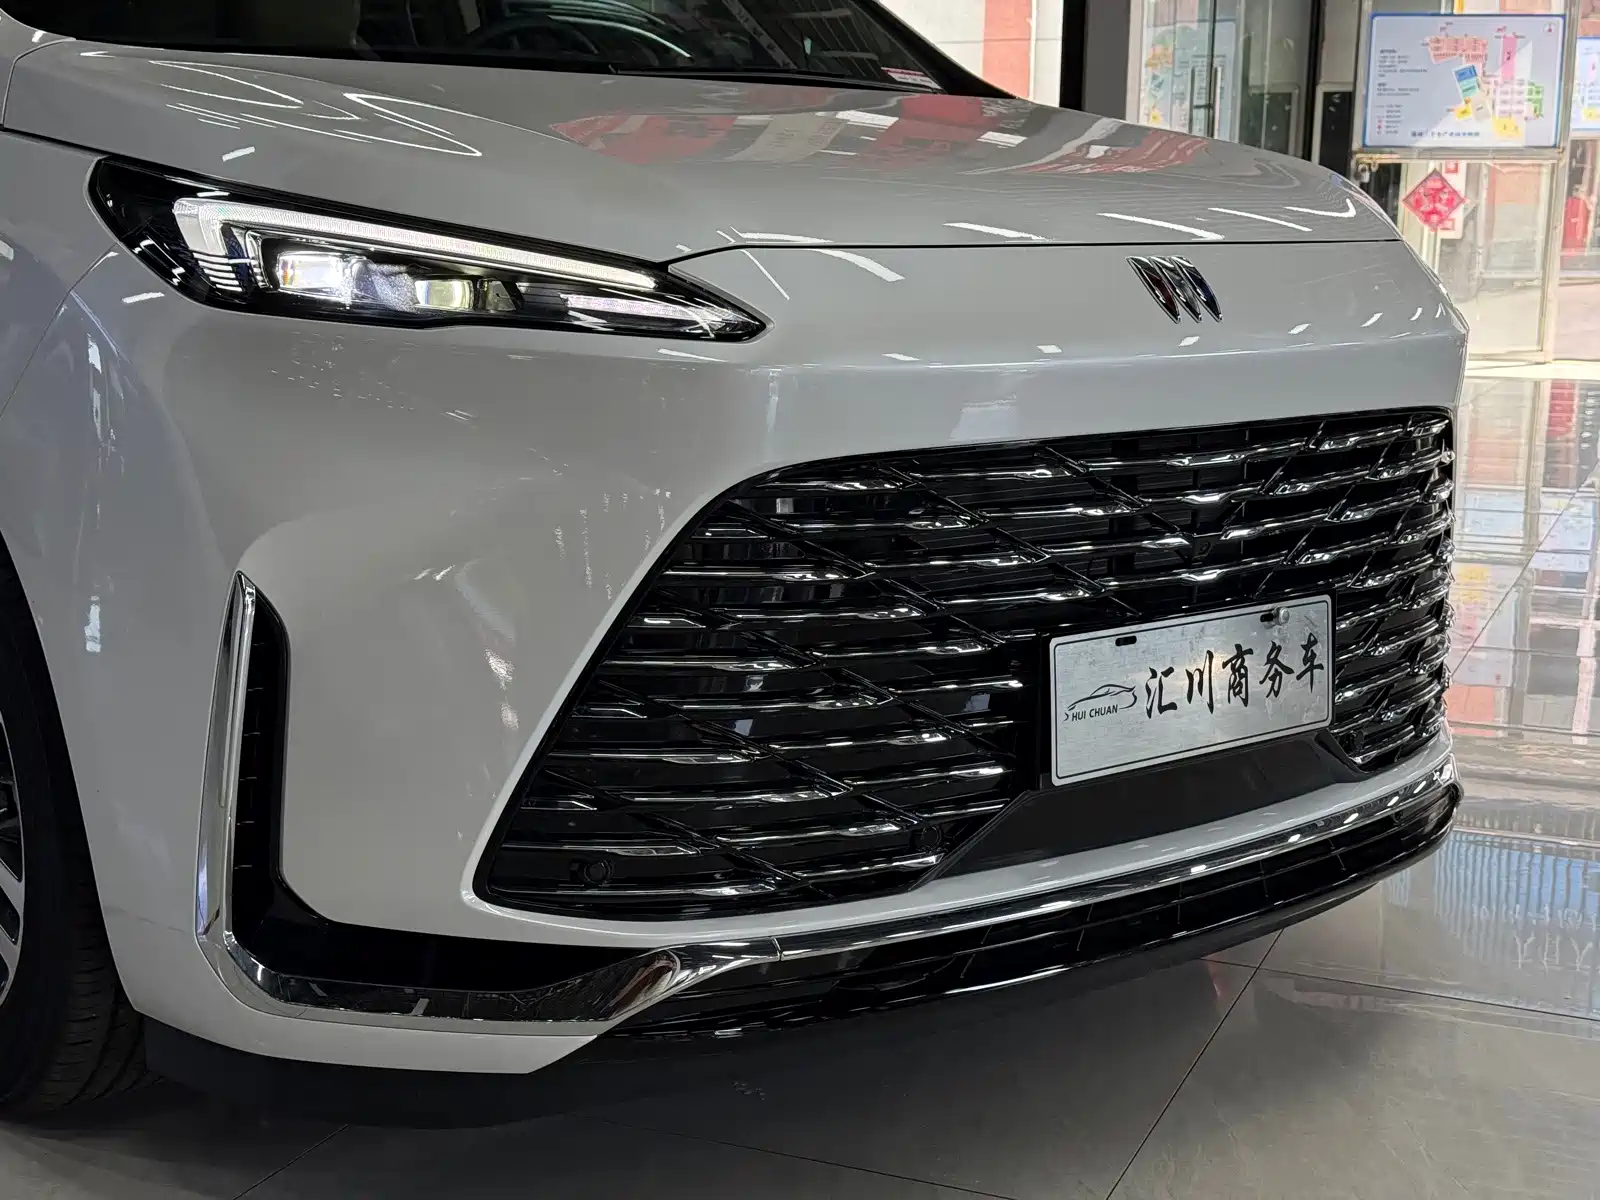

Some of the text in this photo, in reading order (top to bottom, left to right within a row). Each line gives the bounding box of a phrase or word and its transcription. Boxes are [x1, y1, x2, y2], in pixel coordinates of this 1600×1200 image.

[1144, 632, 1325, 719] 汇川商务车
[1071, 704, 1119, 722] HUI CHUAN
